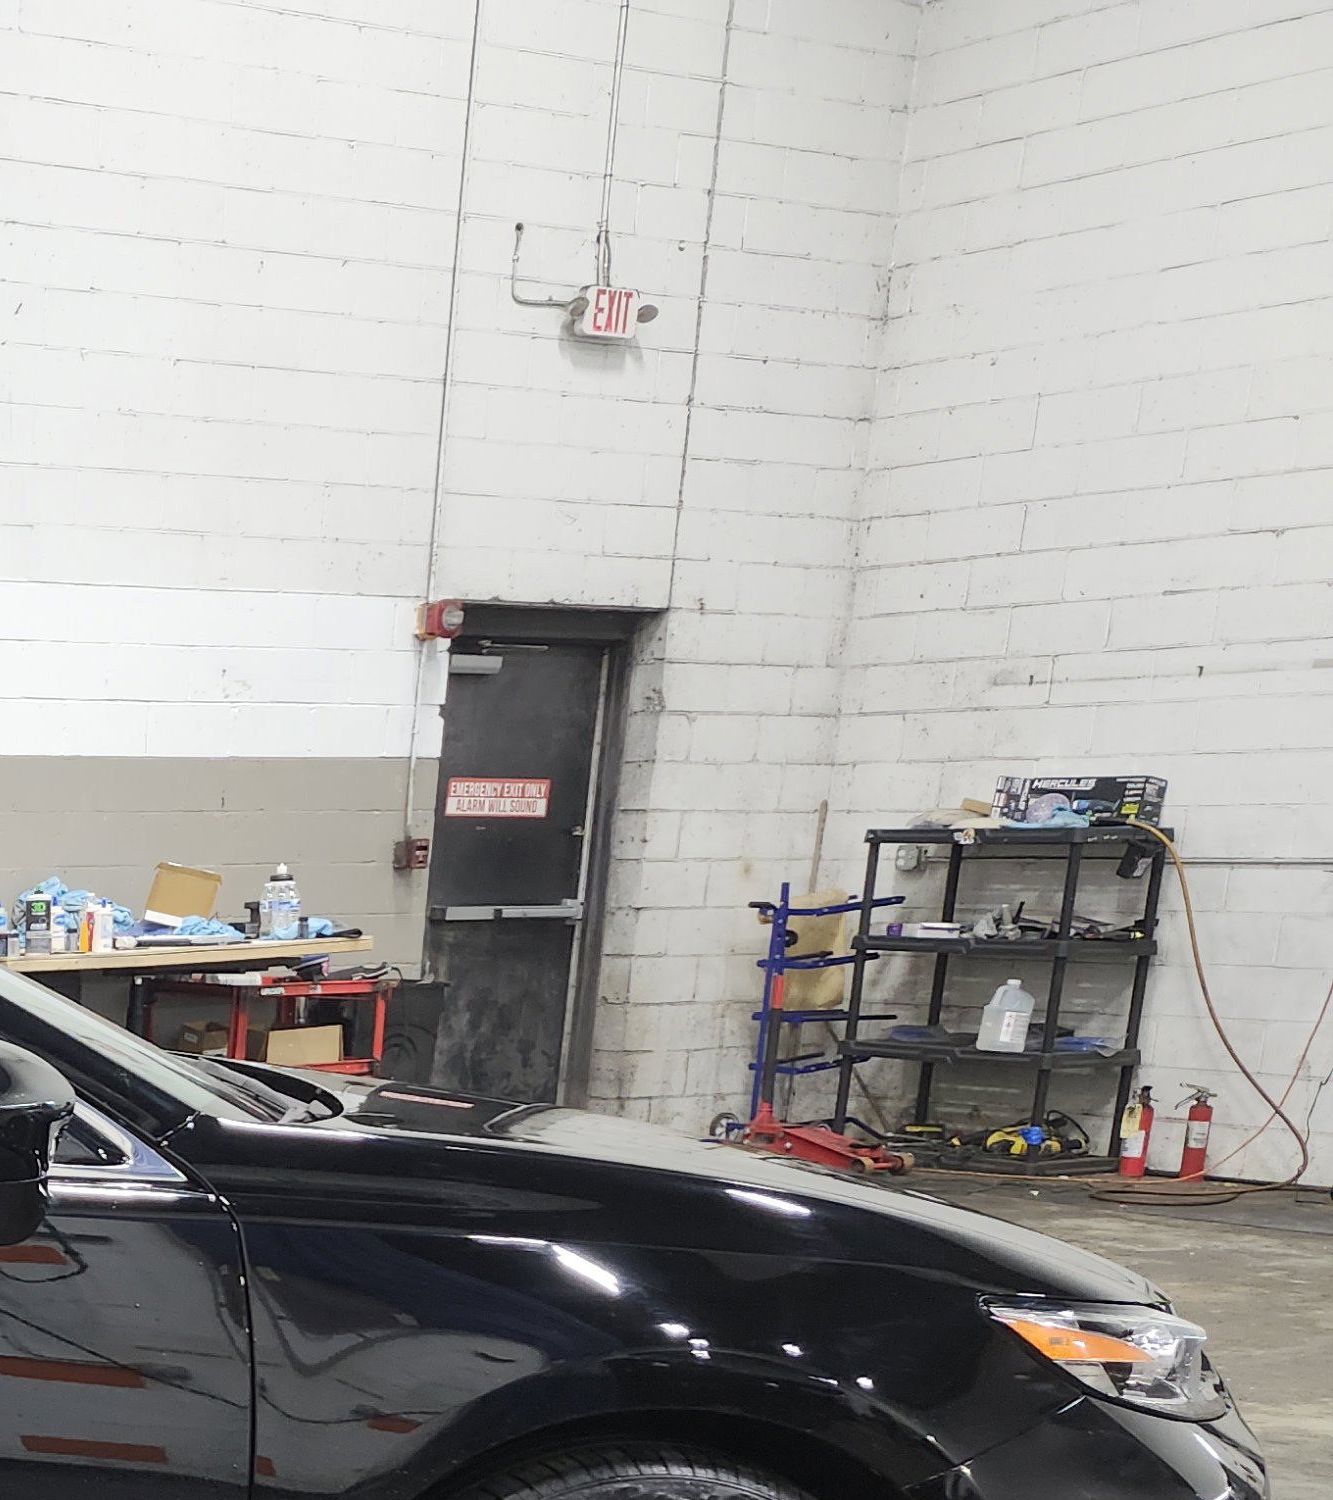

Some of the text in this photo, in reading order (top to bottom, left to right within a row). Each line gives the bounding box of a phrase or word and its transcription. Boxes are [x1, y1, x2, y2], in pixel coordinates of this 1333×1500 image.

[593, 289, 633, 334] EXIT
[450, 782, 546, 797] EMERGENCY EXIT ONLY
[1032, 779, 1097, 790] HERCULES
[456, 799, 537, 813] ALARM WILL SOUND
